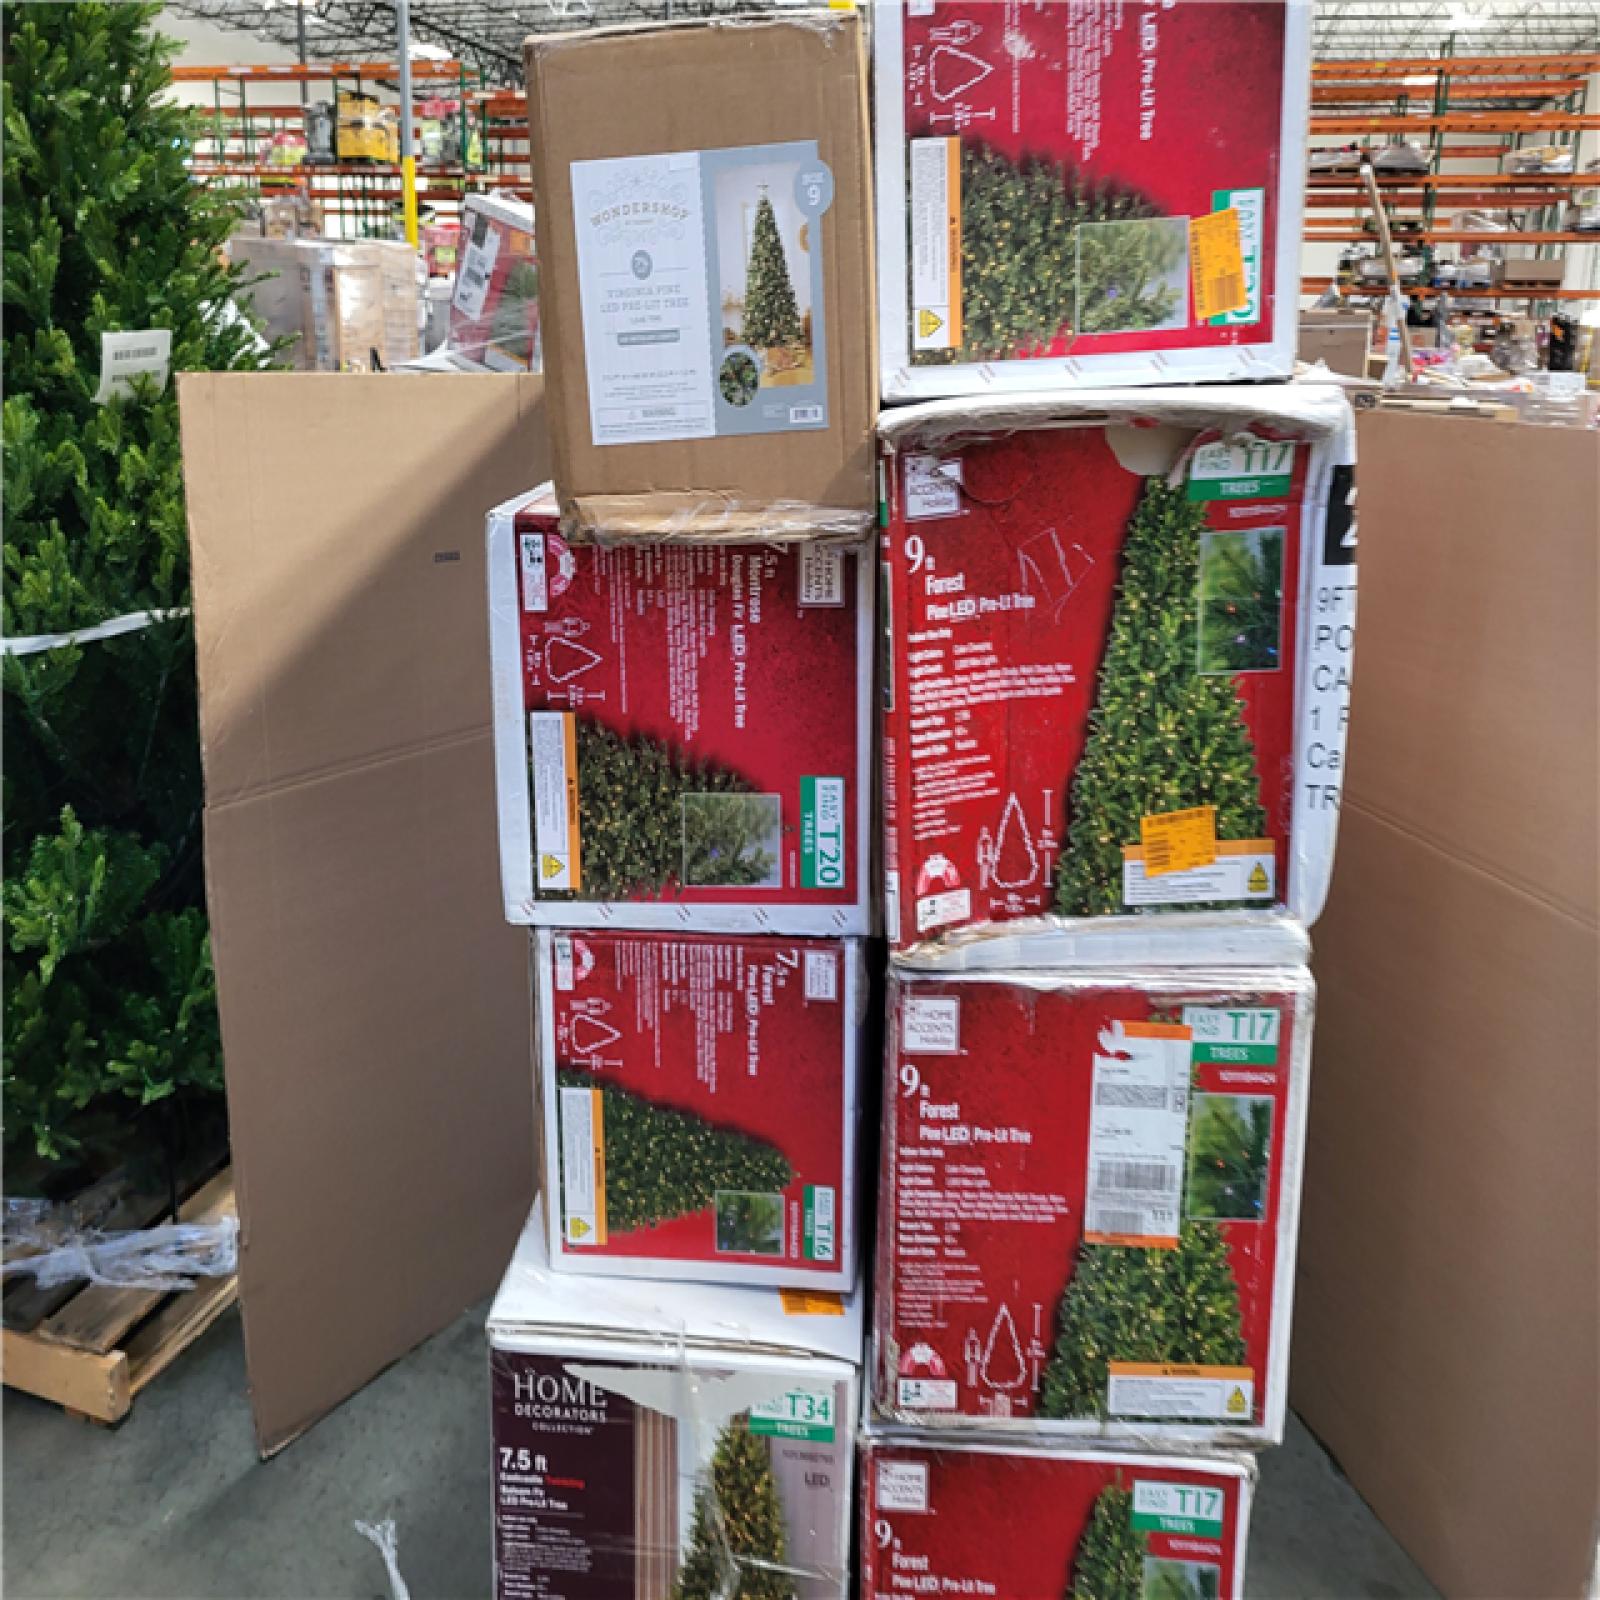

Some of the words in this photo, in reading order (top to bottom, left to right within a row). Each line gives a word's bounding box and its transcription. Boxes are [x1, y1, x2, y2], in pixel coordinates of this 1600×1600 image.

[1140, 59, 1156, 107] Pre-Lit
[1140, 110, 1155, 140] Tree
[807, 184, 821, 206] 9
[588, 201, 690, 228] WONDERSHOP
[904, 535, 925, 574] 9
[731, 555, 744, 601] Douglas
[749, 555, 761, 624] Montrose
[925, 572, 966, 596] Forest
[733, 604, 745, 621] Fir
[731, 624, 746, 656] LED
[734, 662, 745, 701] Pre-Lit
[735, 704, 746, 729] Tree
[804, 811, 813, 854] TREES
[820, 823, 840, 883] T20
[763, 965, 775, 1005] Forest
[1226, 1011, 1275, 1041] T17
[1209, 1046, 1250, 1060] TREES
[899, 1065, 920, 1097] 9
[920, 1102, 960, 1119] Forest
[816, 1220, 833, 1256] T16
[513, 1402, 608, 1423] DECORATORS
[784, 1391, 831, 1421] T34
[499, 1447, 531, 1471] 7.5
[1173, 1487, 1219, 1516] T17
[875, 1520, 892, 1548] 9
[1158, 1518, 1196, 1533] TREES
[892, 1553, 928, 1570] Forest
